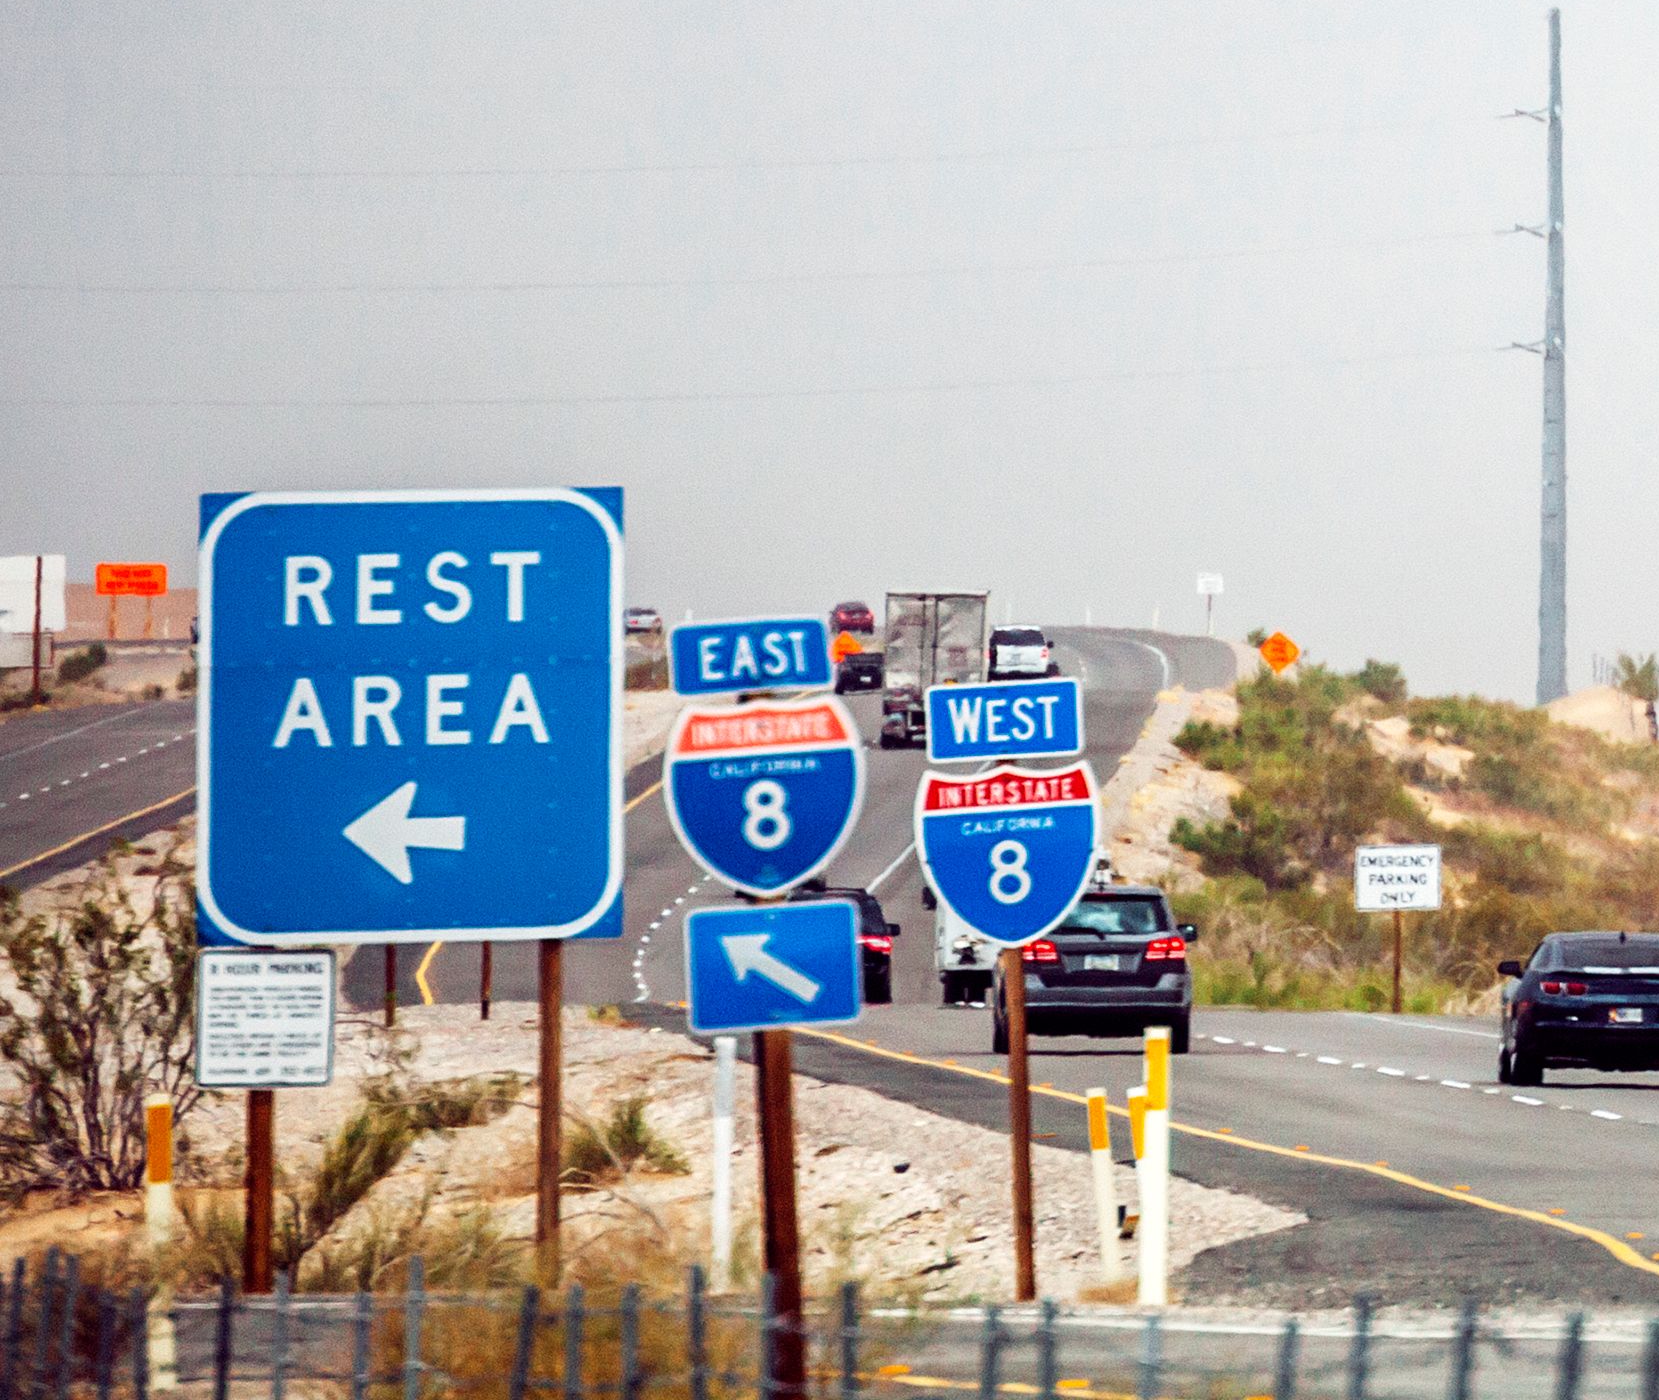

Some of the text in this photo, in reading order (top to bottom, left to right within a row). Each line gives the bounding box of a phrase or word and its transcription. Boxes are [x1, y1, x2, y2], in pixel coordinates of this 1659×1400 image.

[283, 551, 541, 626] REST
[700, 632, 805, 681] EAST
[272, 672, 550, 749] AREA
[691, 711, 829, 747] INTERSTATE
[947, 696, 1060, 744] WEST
[938, 777, 1074, 807] INTERSTATE
[743, 780, 791, 850] 8
[961, 816, 1055, 835] CALIFORNIA
[989, 839, 1031, 904] 8
[1360, 856, 1434, 867] EMERGENCY
[1369, 873, 1427, 885] PARKING
[1380, 891, 1415, 904] ONLY
